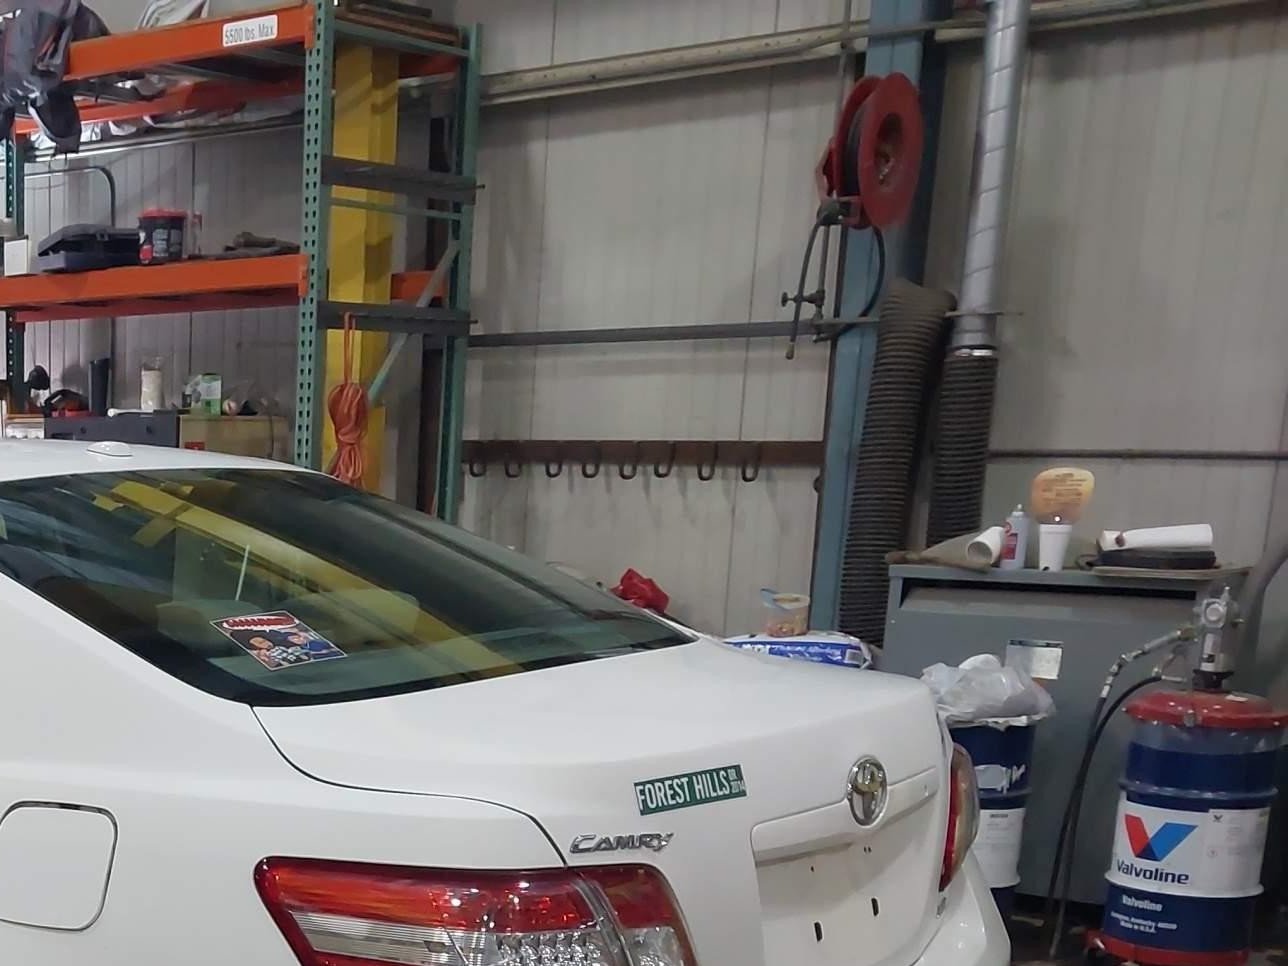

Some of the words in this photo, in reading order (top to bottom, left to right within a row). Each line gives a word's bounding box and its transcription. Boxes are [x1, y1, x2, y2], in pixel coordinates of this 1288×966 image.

[634, 776, 691, 811] FOREST
[692, 769, 731, 800] HILLS
[569, 832, 674, 854] CAMRY
[1116, 858, 1190, 885] Valvoline
[1122, 894, 1163, 912] Valvoline
